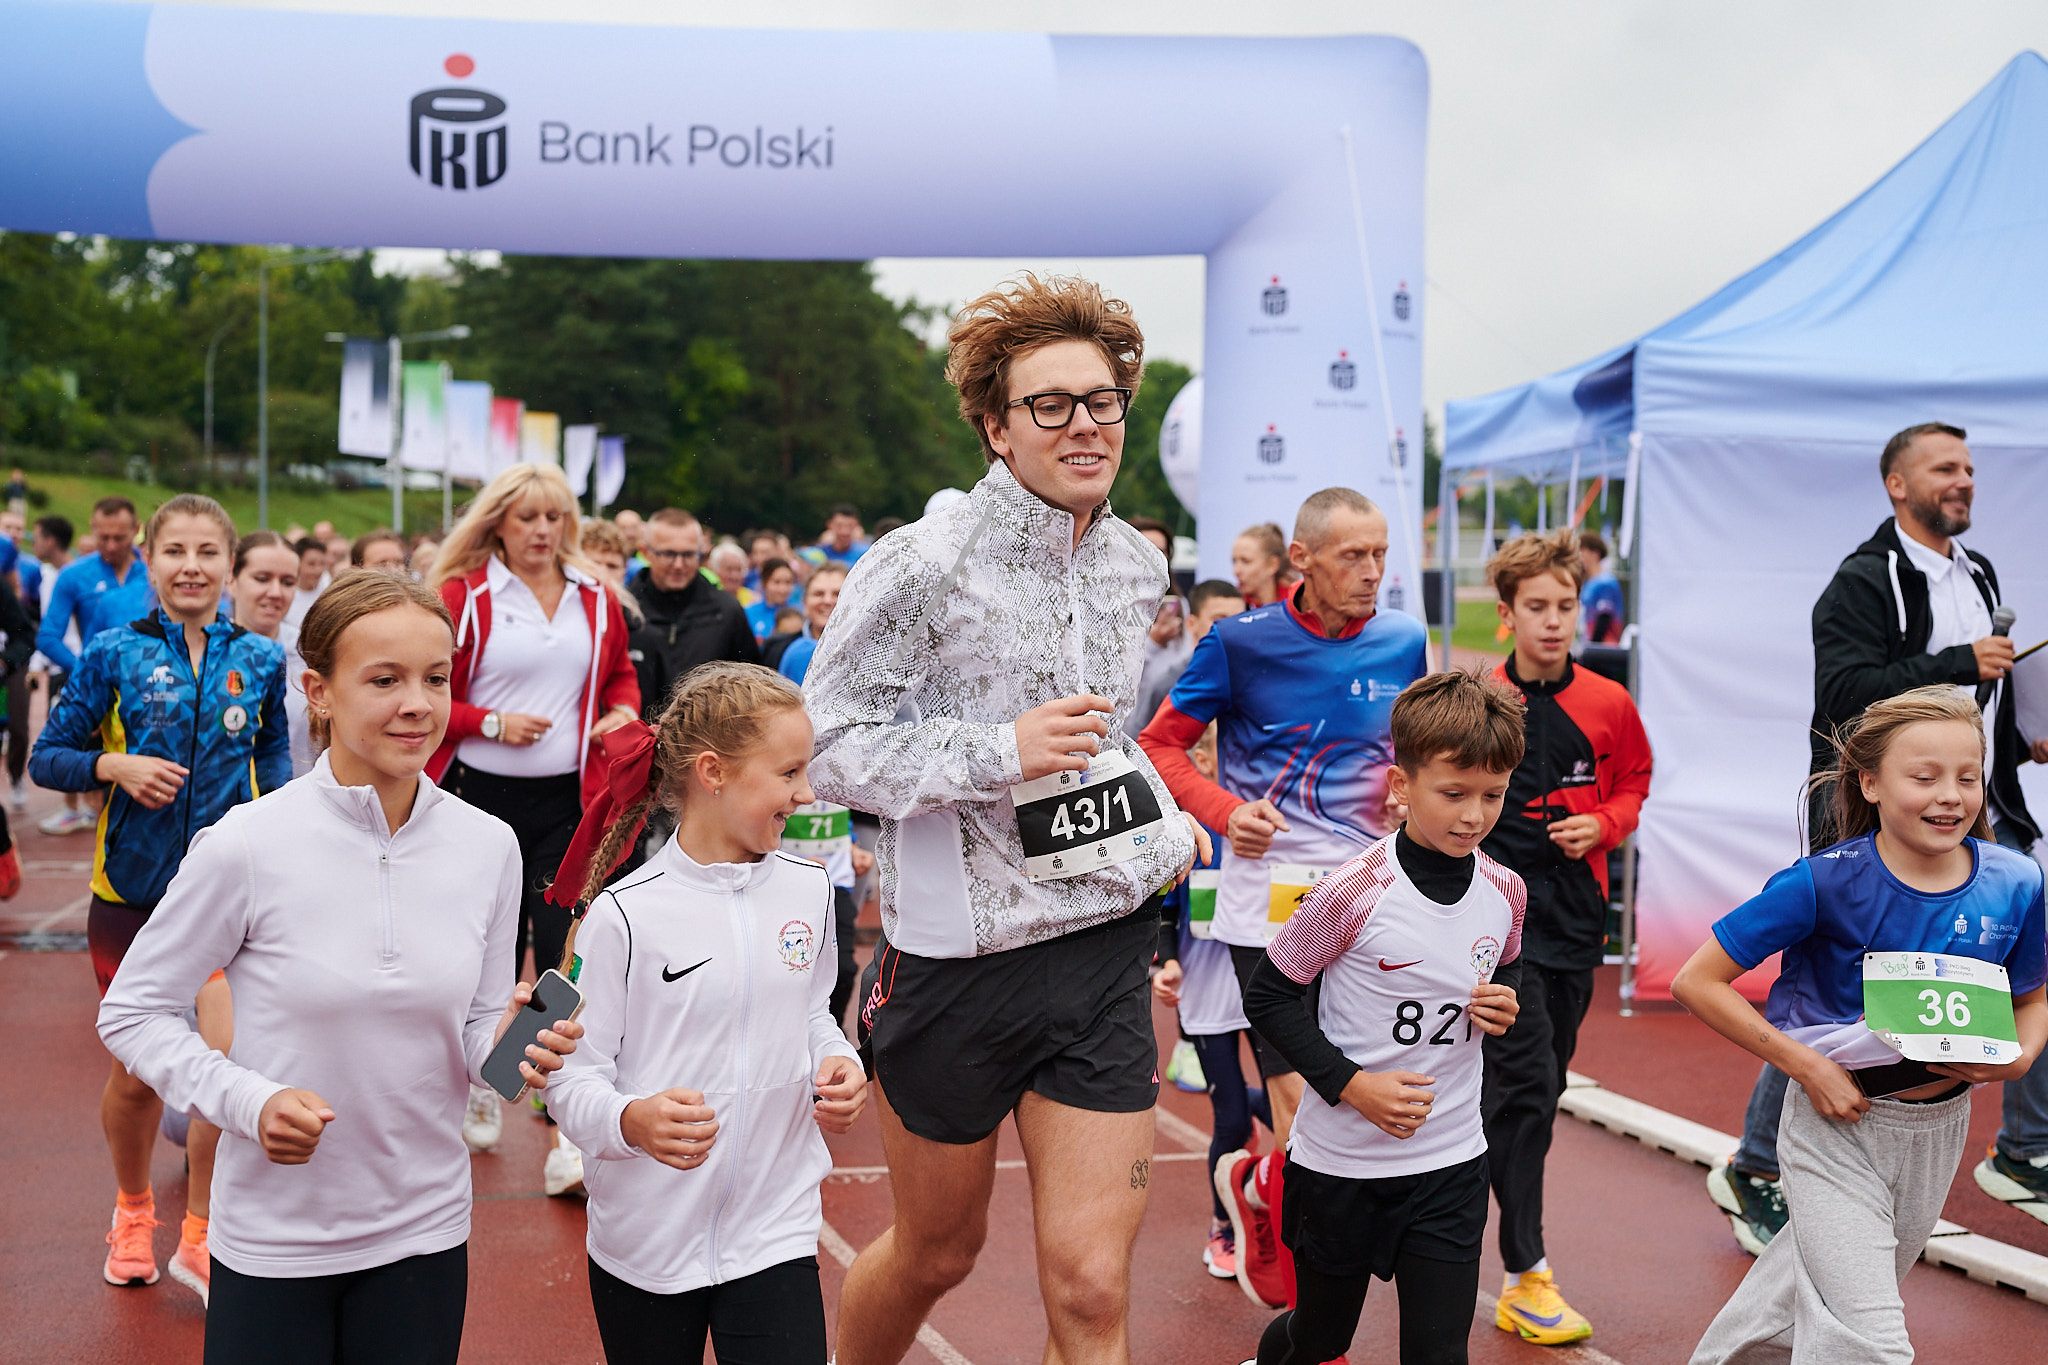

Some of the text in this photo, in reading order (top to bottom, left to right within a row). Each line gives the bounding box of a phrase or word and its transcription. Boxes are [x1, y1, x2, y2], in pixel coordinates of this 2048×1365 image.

[539, 121, 835, 169] Bank Polski
[809, 816, 833, 838] 71
[1050, 784, 1133, 841] 43/1
[1917, 988, 1971, 1028] 36
